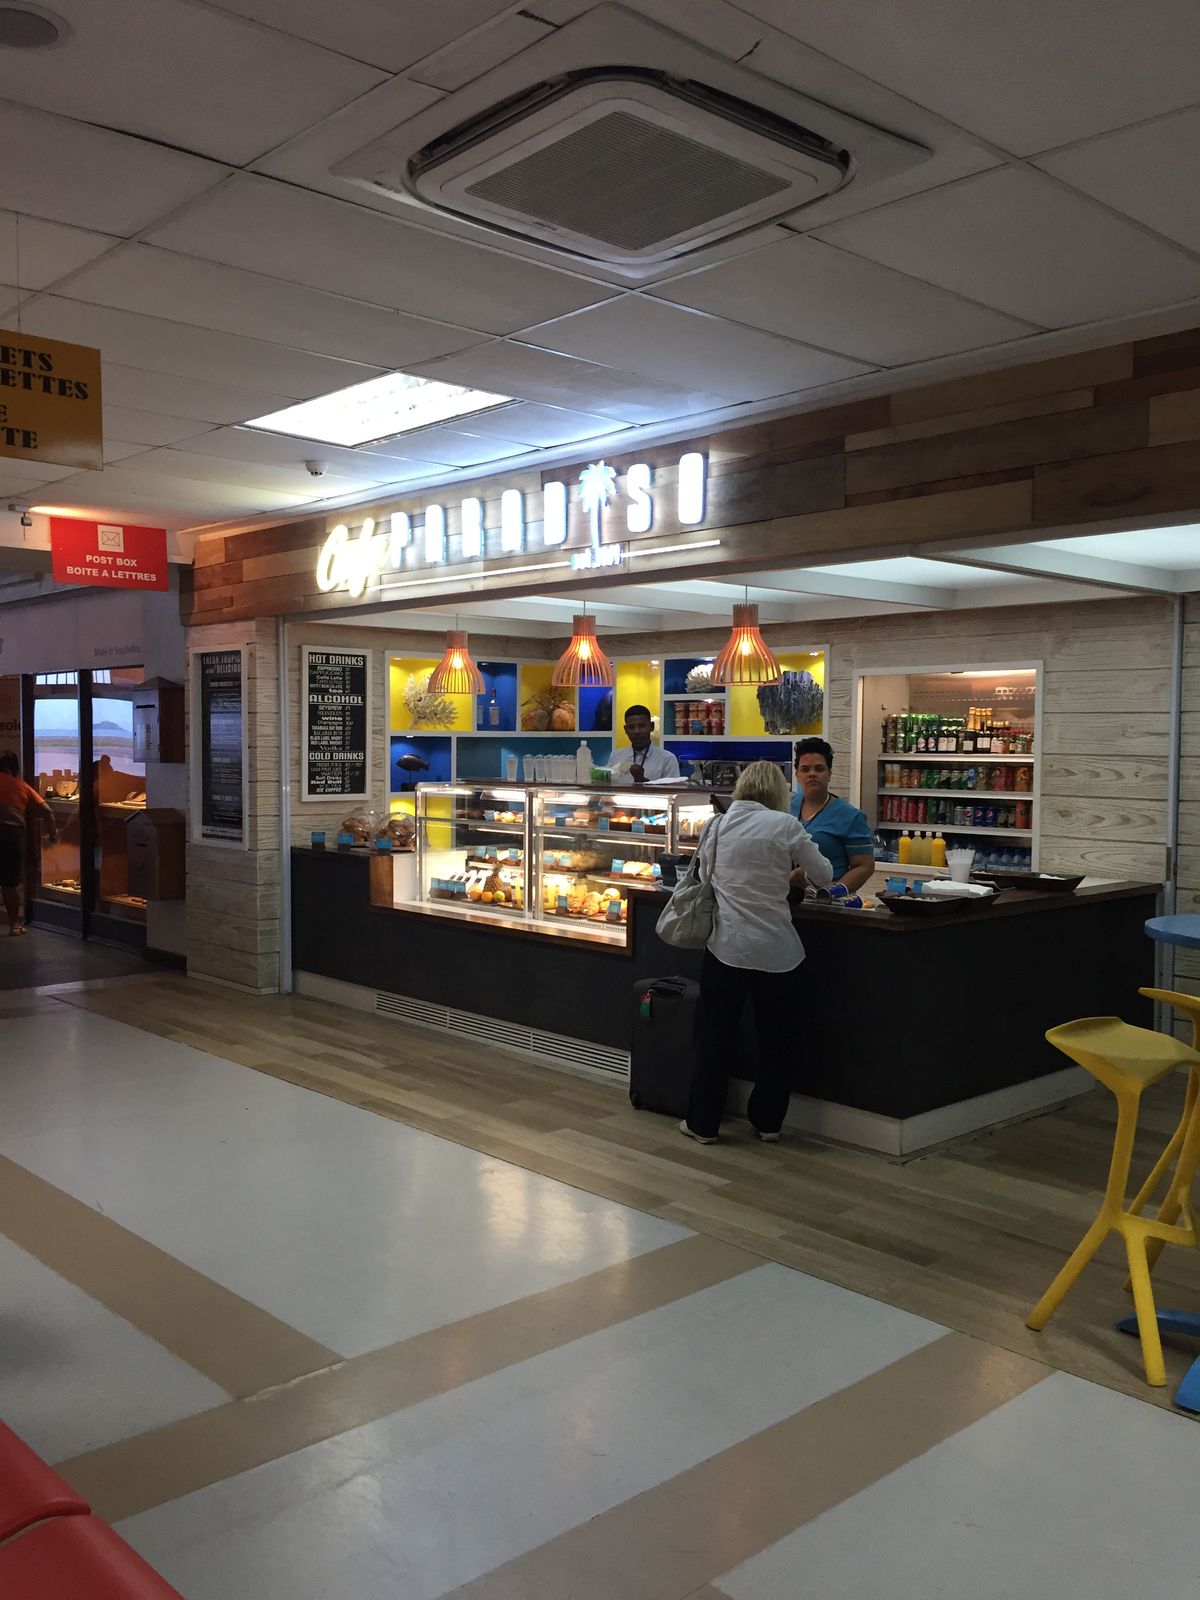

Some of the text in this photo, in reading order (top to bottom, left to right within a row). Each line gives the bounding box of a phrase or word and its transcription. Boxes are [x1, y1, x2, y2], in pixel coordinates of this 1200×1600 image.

[86, 554, 138, 567] POST BOX
[66, 566, 157, 582] BOITE A LETTRES
[309, 654, 364, 666] HOT DRINKS
[309, 695, 363, 704] ALCOHOL
[309, 752, 364, 760] COLD DRINKS
